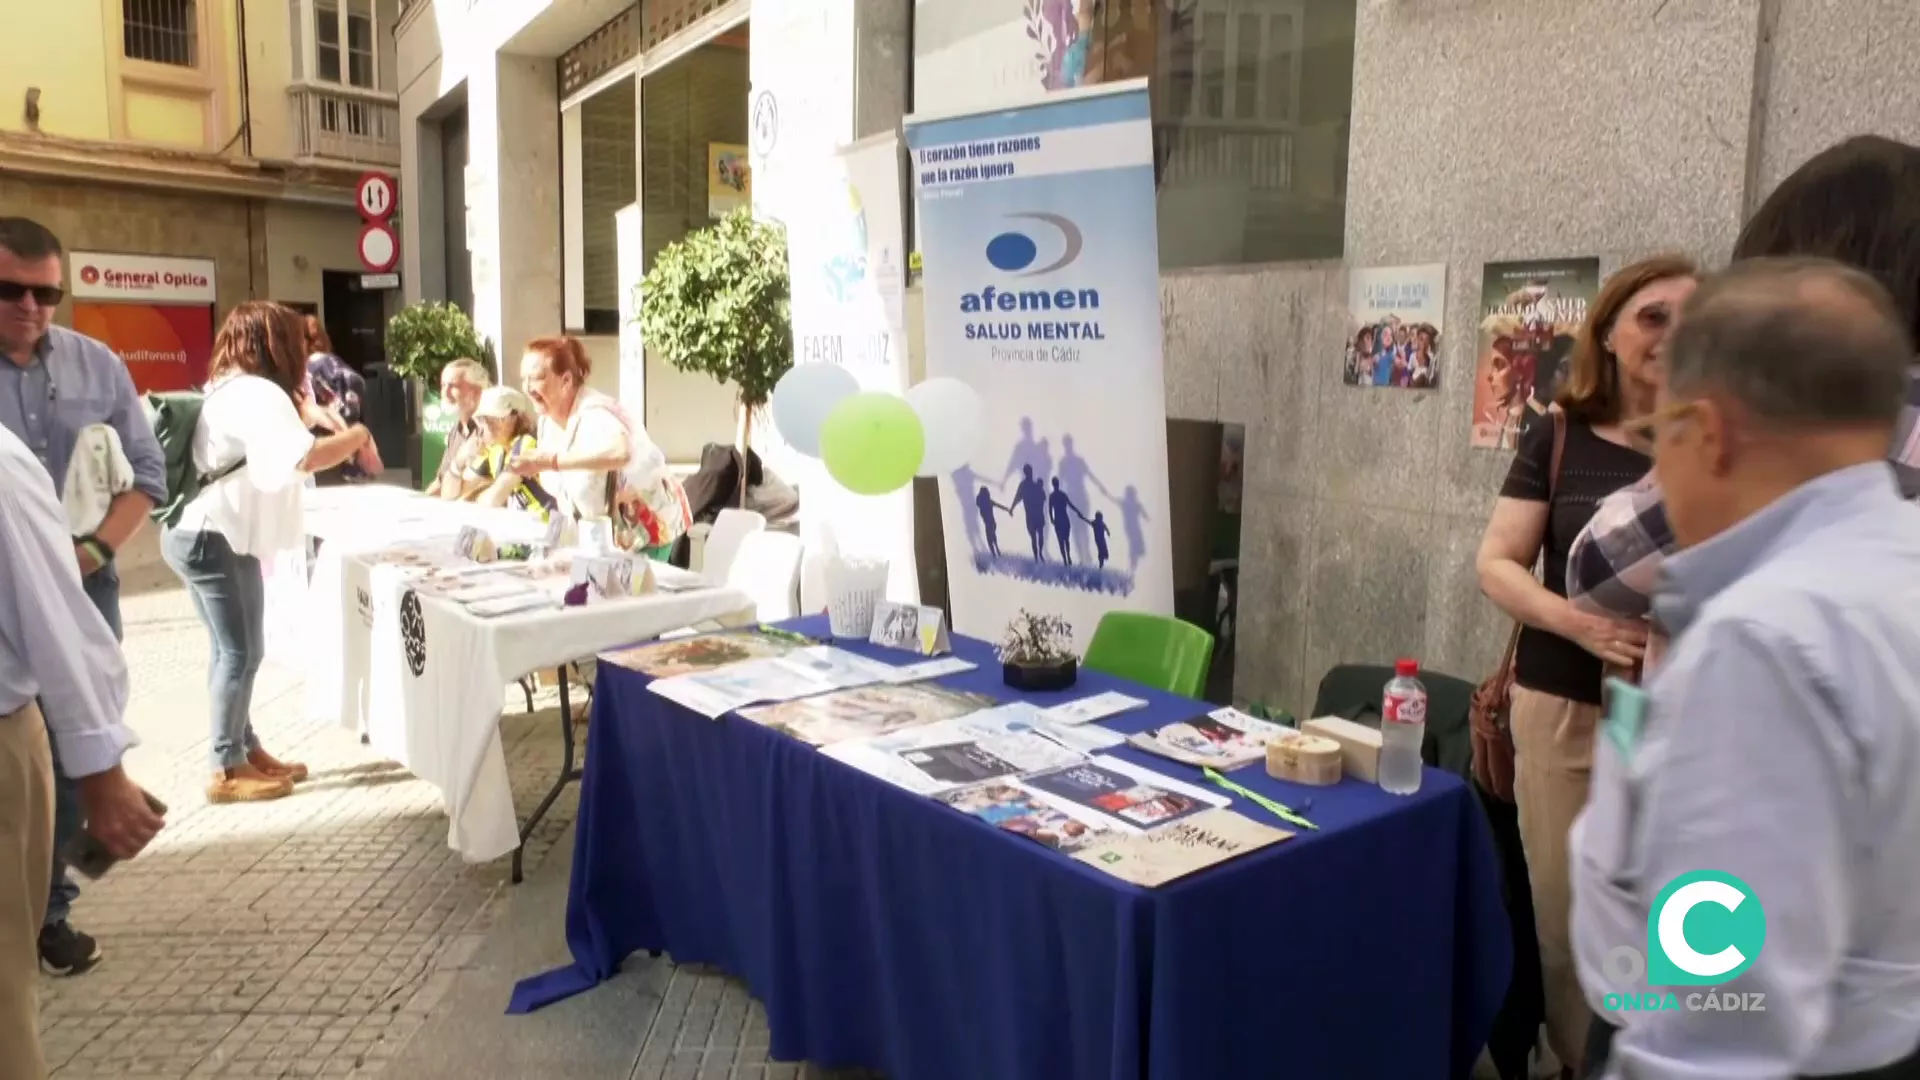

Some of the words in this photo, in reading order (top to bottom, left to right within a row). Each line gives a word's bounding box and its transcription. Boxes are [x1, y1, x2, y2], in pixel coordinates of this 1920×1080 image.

[927, 143, 967, 163] corazón
[968, 140, 995, 159] tiene
[997, 135, 1041, 153] razones
[920, 170, 936, 186] que
[938, 166, 948, 183] la
[949, 163, 979, 181] razón
[980, 160, 1015, 180] ignora
[104, 268, 160, 287] General
[163, 271, 208, 289] Optica
[960, 284, 1100, 314] afemen
[965, 322, 1022, 341] SALUD
[1028, 321, 1105, 341] MENTAL
[991, 345, 1034, 362] Provincia
[1036, 346, 1049, 361] de
[1051, 344, 1081, 363] Cádiz
